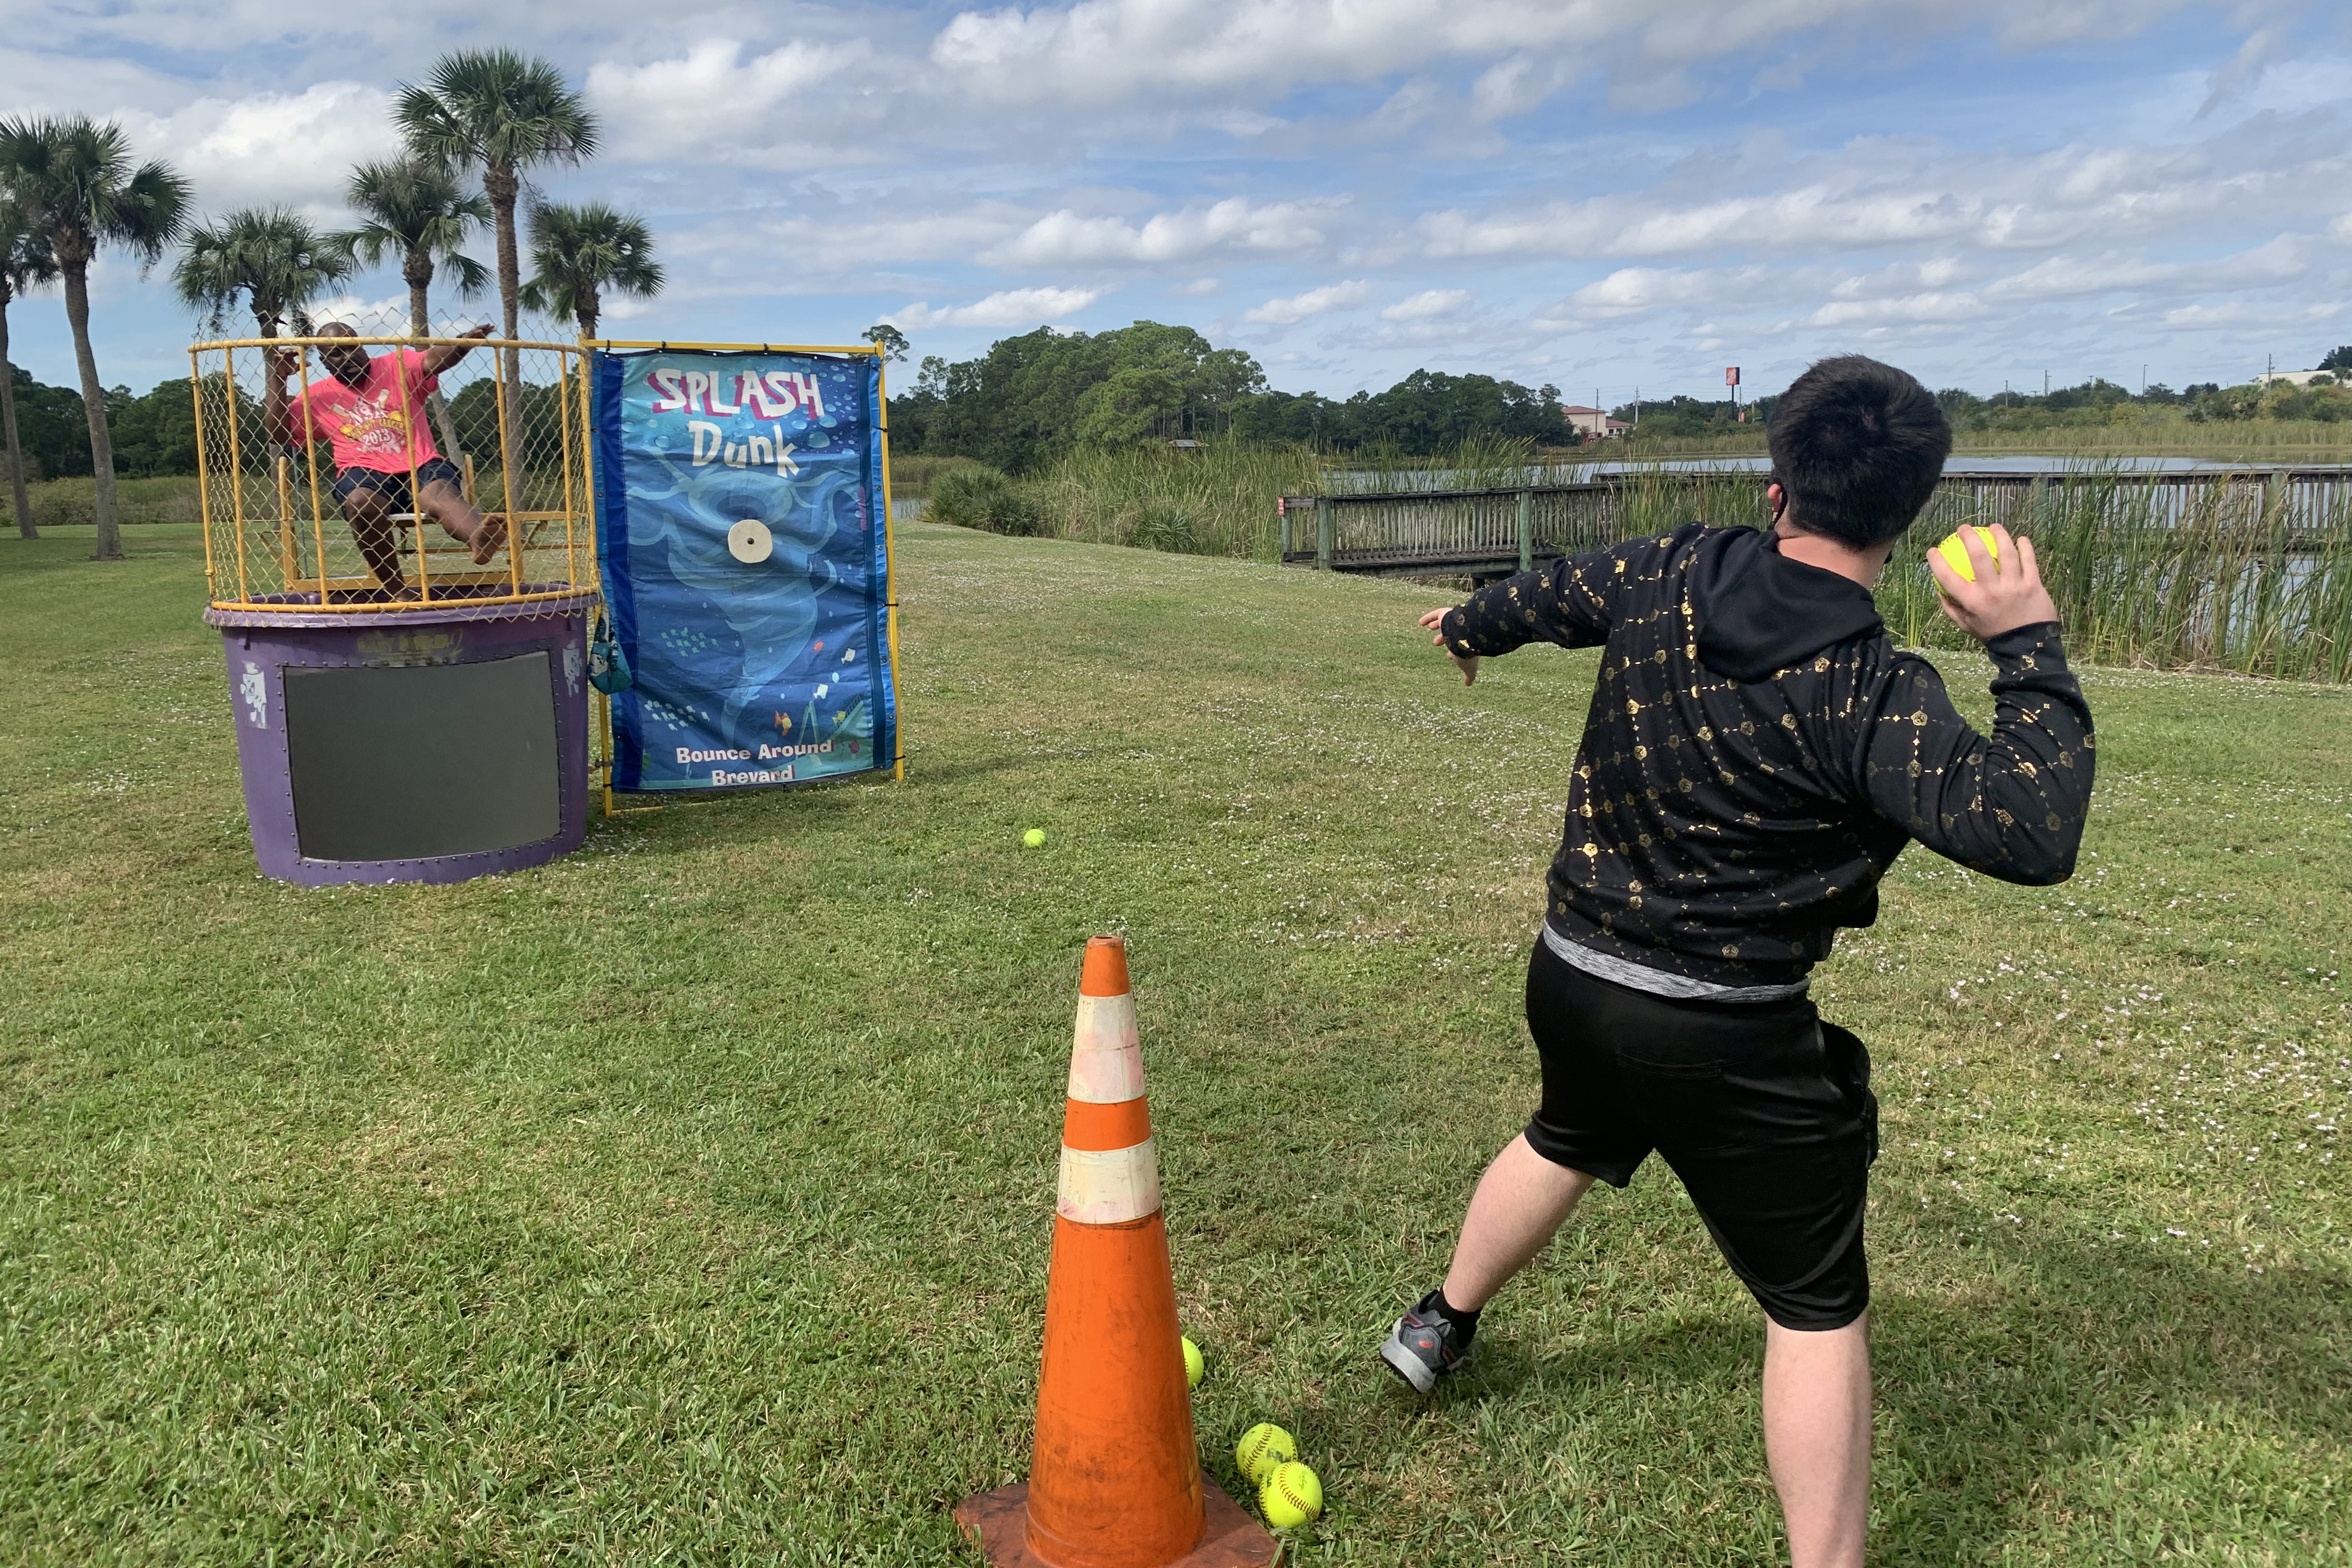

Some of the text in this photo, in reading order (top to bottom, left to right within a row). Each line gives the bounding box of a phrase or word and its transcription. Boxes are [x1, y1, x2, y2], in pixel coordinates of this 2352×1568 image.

[648, 368, 824, 419] SPLASH
[362, 428, 391, 446] 2013
[688, 421, 800, 478] Dunk
[676, 740, 834, 764] Bounce Around
[712, 765, 794, 786] Brevard
